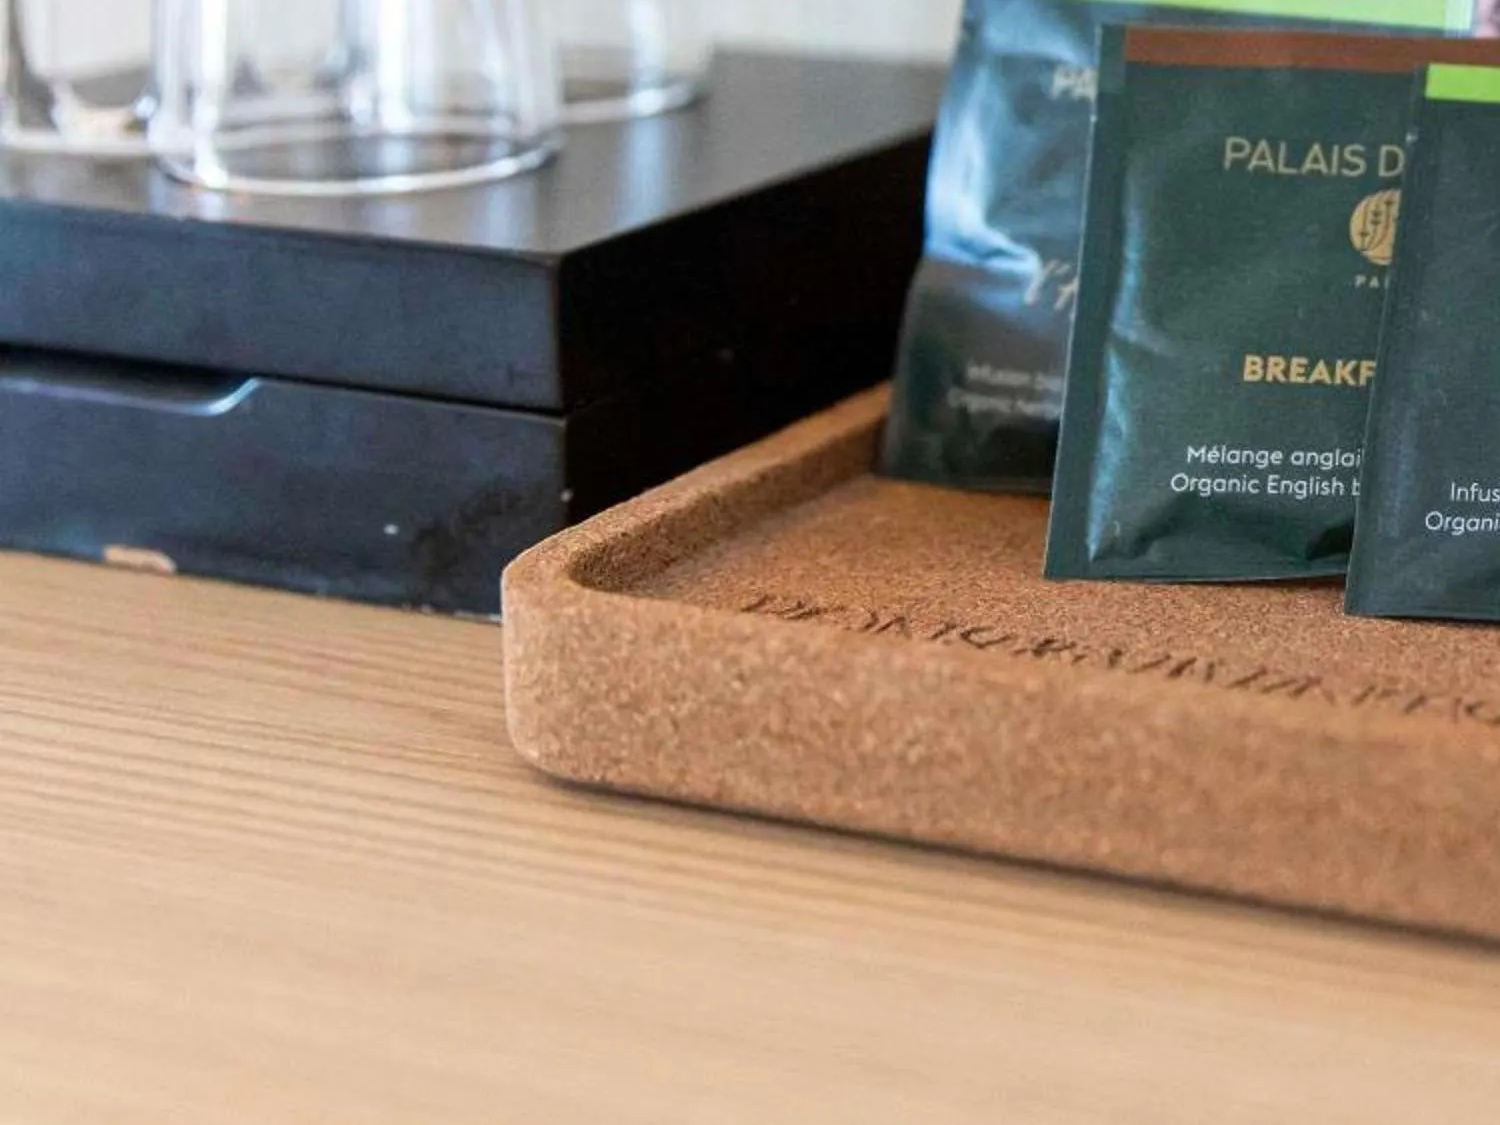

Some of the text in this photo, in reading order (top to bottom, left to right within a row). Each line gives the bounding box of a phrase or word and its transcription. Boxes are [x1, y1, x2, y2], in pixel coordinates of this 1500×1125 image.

[1224, 136, 1367, 177] PALAIS
[1187, 445, 1283, 469] Mélange
[1170, 472, 1260, 496] Organic
[1267, 474, 1344, 499] English
